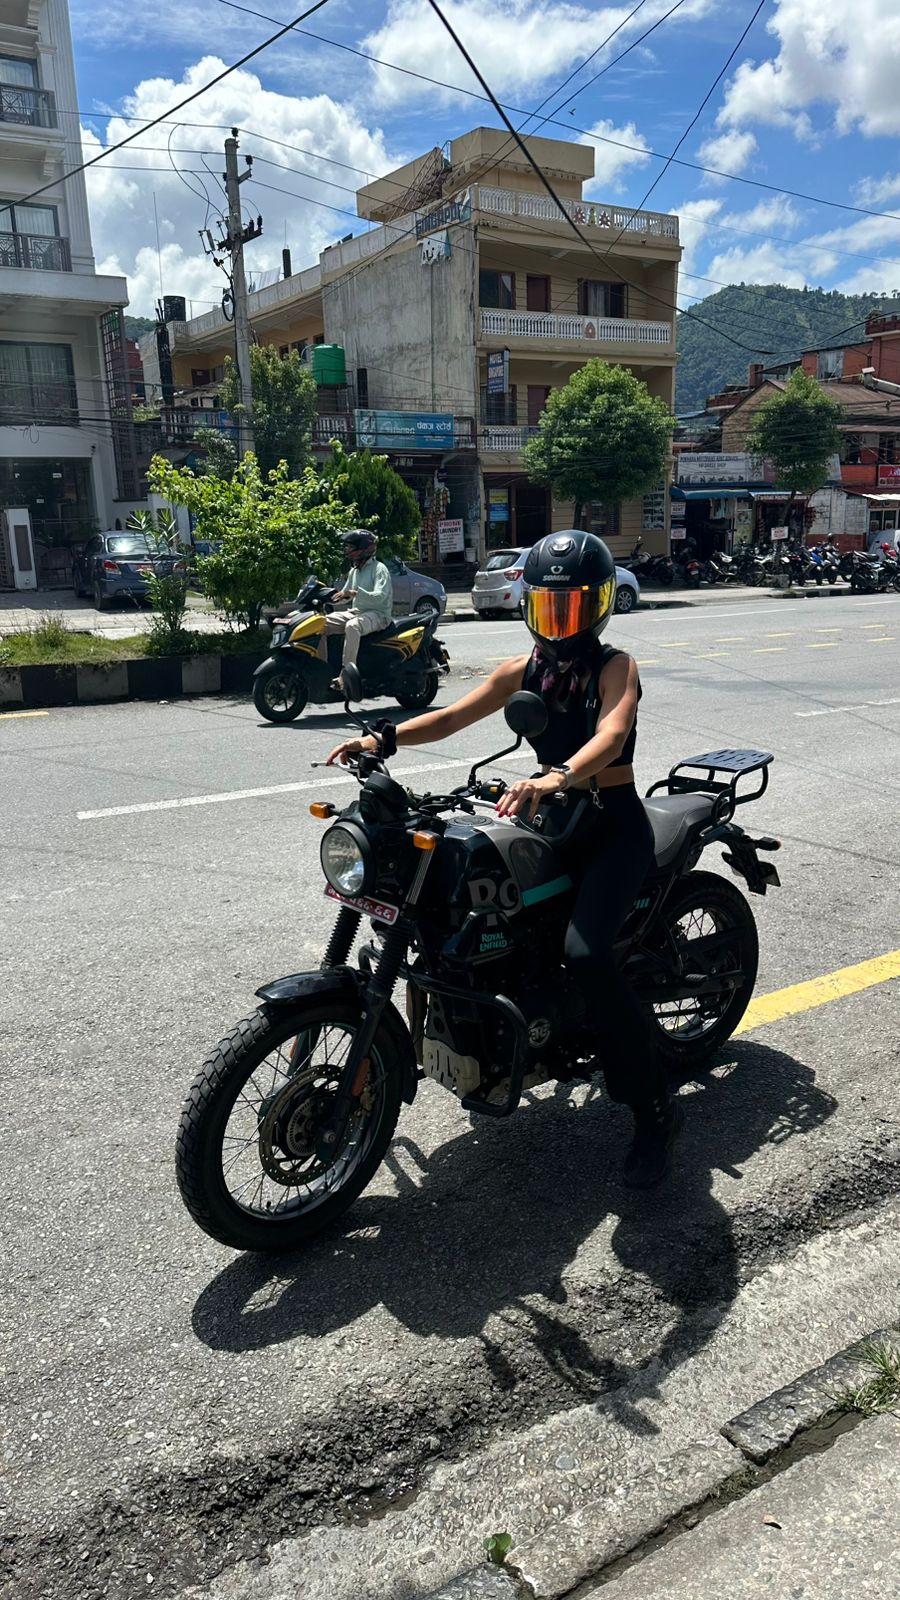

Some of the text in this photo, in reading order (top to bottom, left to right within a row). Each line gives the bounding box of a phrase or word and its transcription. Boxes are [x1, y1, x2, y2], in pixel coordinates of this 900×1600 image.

[542, 574, 571, 582] SOMAN
[481, 932, 504, 943] ROYAL
[479, 940, 507, 952] ENFIELD
